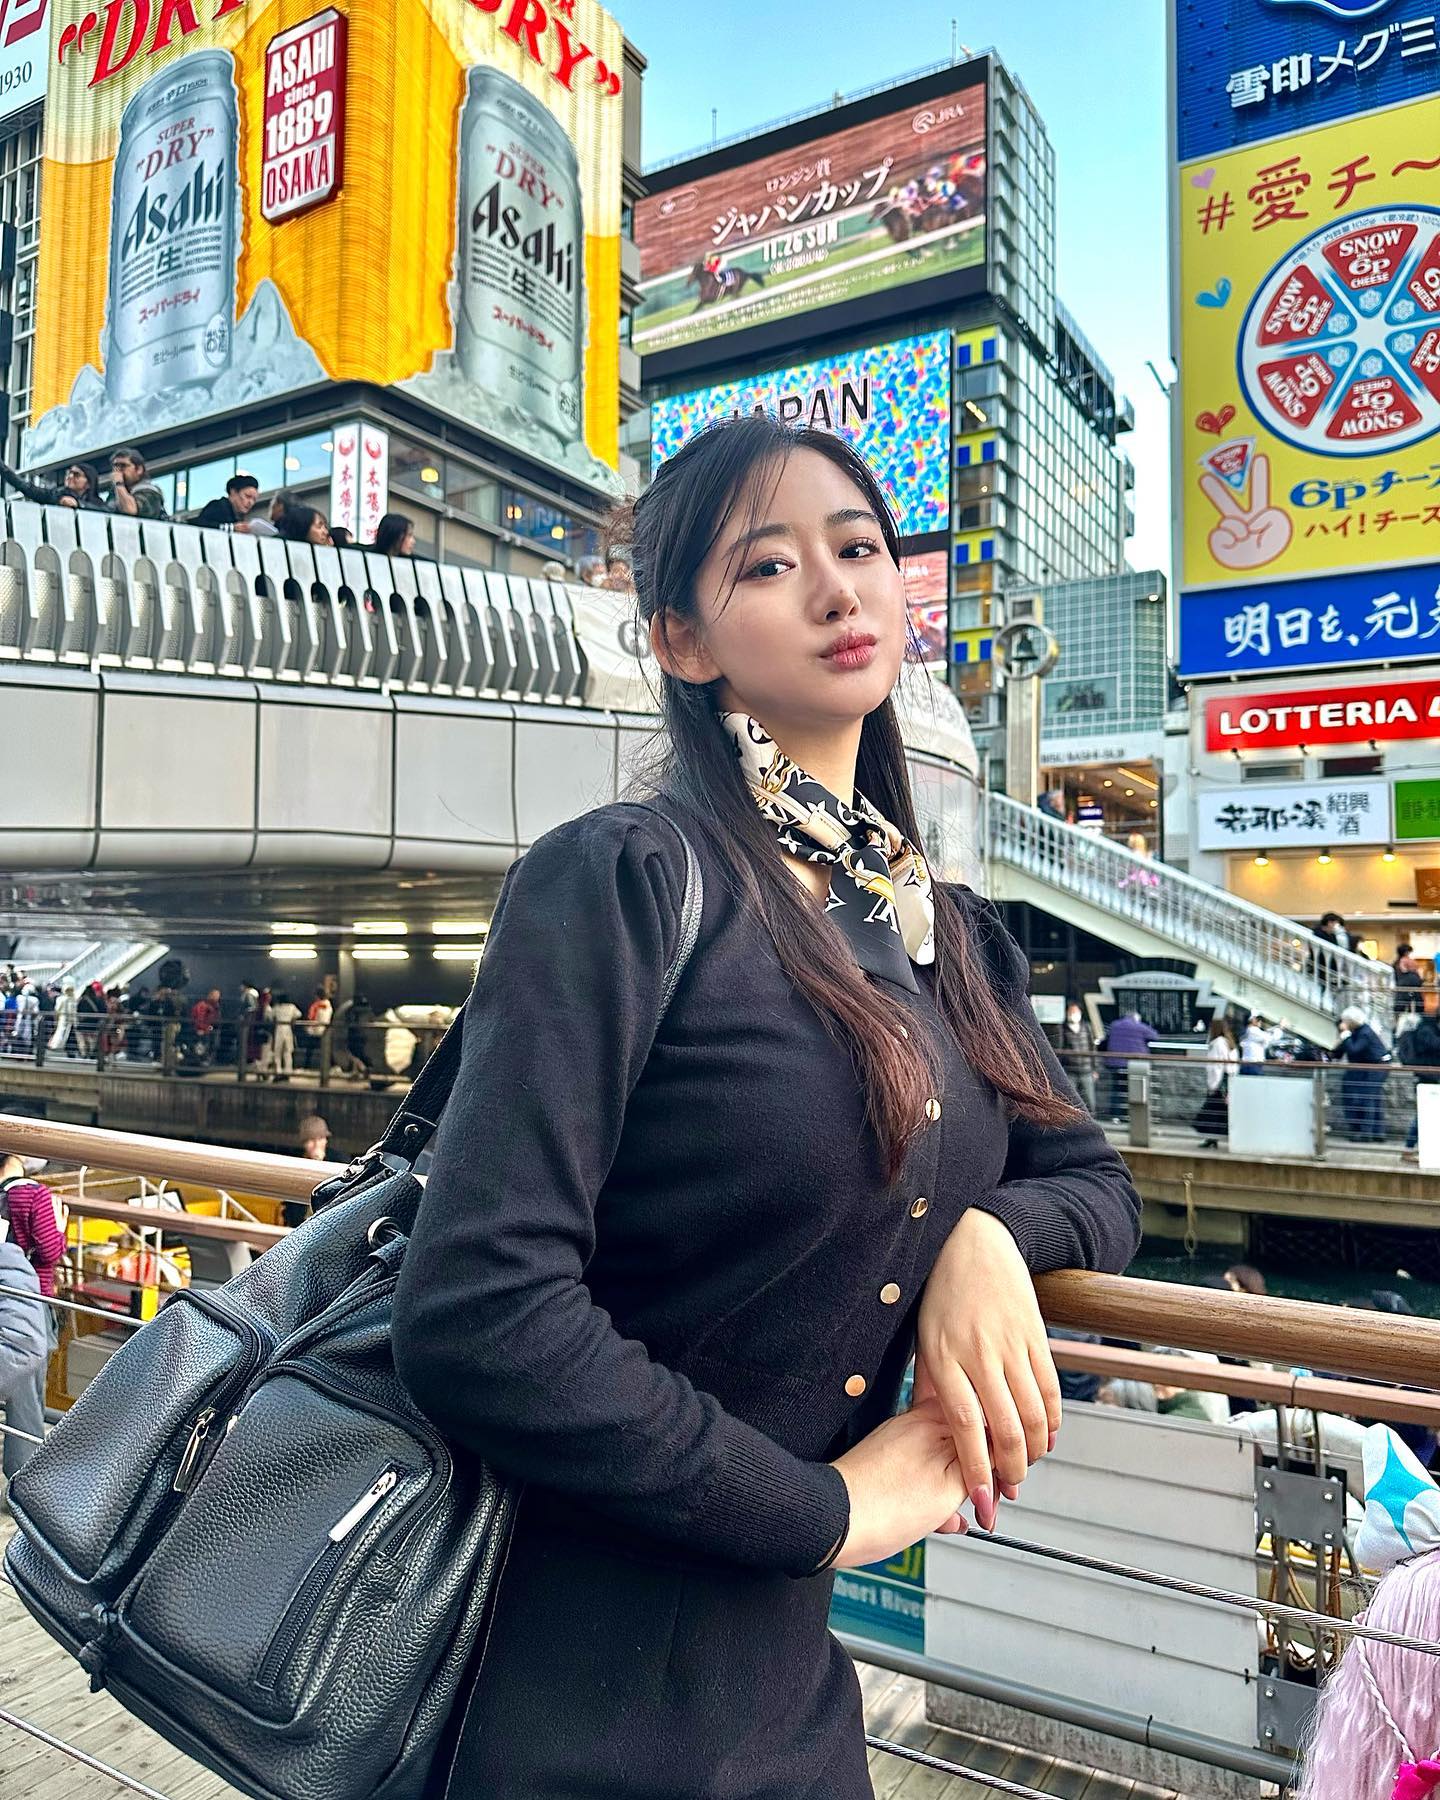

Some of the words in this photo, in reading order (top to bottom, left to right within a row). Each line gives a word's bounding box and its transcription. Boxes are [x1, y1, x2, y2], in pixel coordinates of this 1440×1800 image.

[268, 25, 335, 98] ASAHI
[1226, 16, 1440, 108] 雪印メグミ
[284, 80, 316, 108] since
[157, 117, 196, 145] SUPER
[266, 90, 334, 159] 1889
[936, 104, 964, 124] JRA
[266, 145, 329, 209] OSAKA
[121, 158, 224, 262] Asahi
[711, 156, 894, 245] ジャパンカップ
[472, 182, 573, 294] Asahi
[806, 219, 839, 249] SUN
[1339, 228, 1404, 257] SNOW
[158, 246, 183, 277] 生
[511, 267, 537, 304] 生
[1351, 272, 1390, 290] CHEESE
[1411, 280, 1438, 311] CHEESE
[138, 288, 201, 324] スーパードライ
[1264, 276, 1304, 335] SNOW
[1307, 300, 1333, 336] CHEESE
[1411, 331, 1437, 368] CHEESE
[1307, 356, 1333, 385] CHEESE
[1352, 379, 1392, 394] CHEESE
[730, 375, 870, 430] PAN
[1263, 371, 1307, 418] SNOW
[1338, 410, 1405, 437] SNOW
[1219, 698, 1418, 736] LOTTERIA
